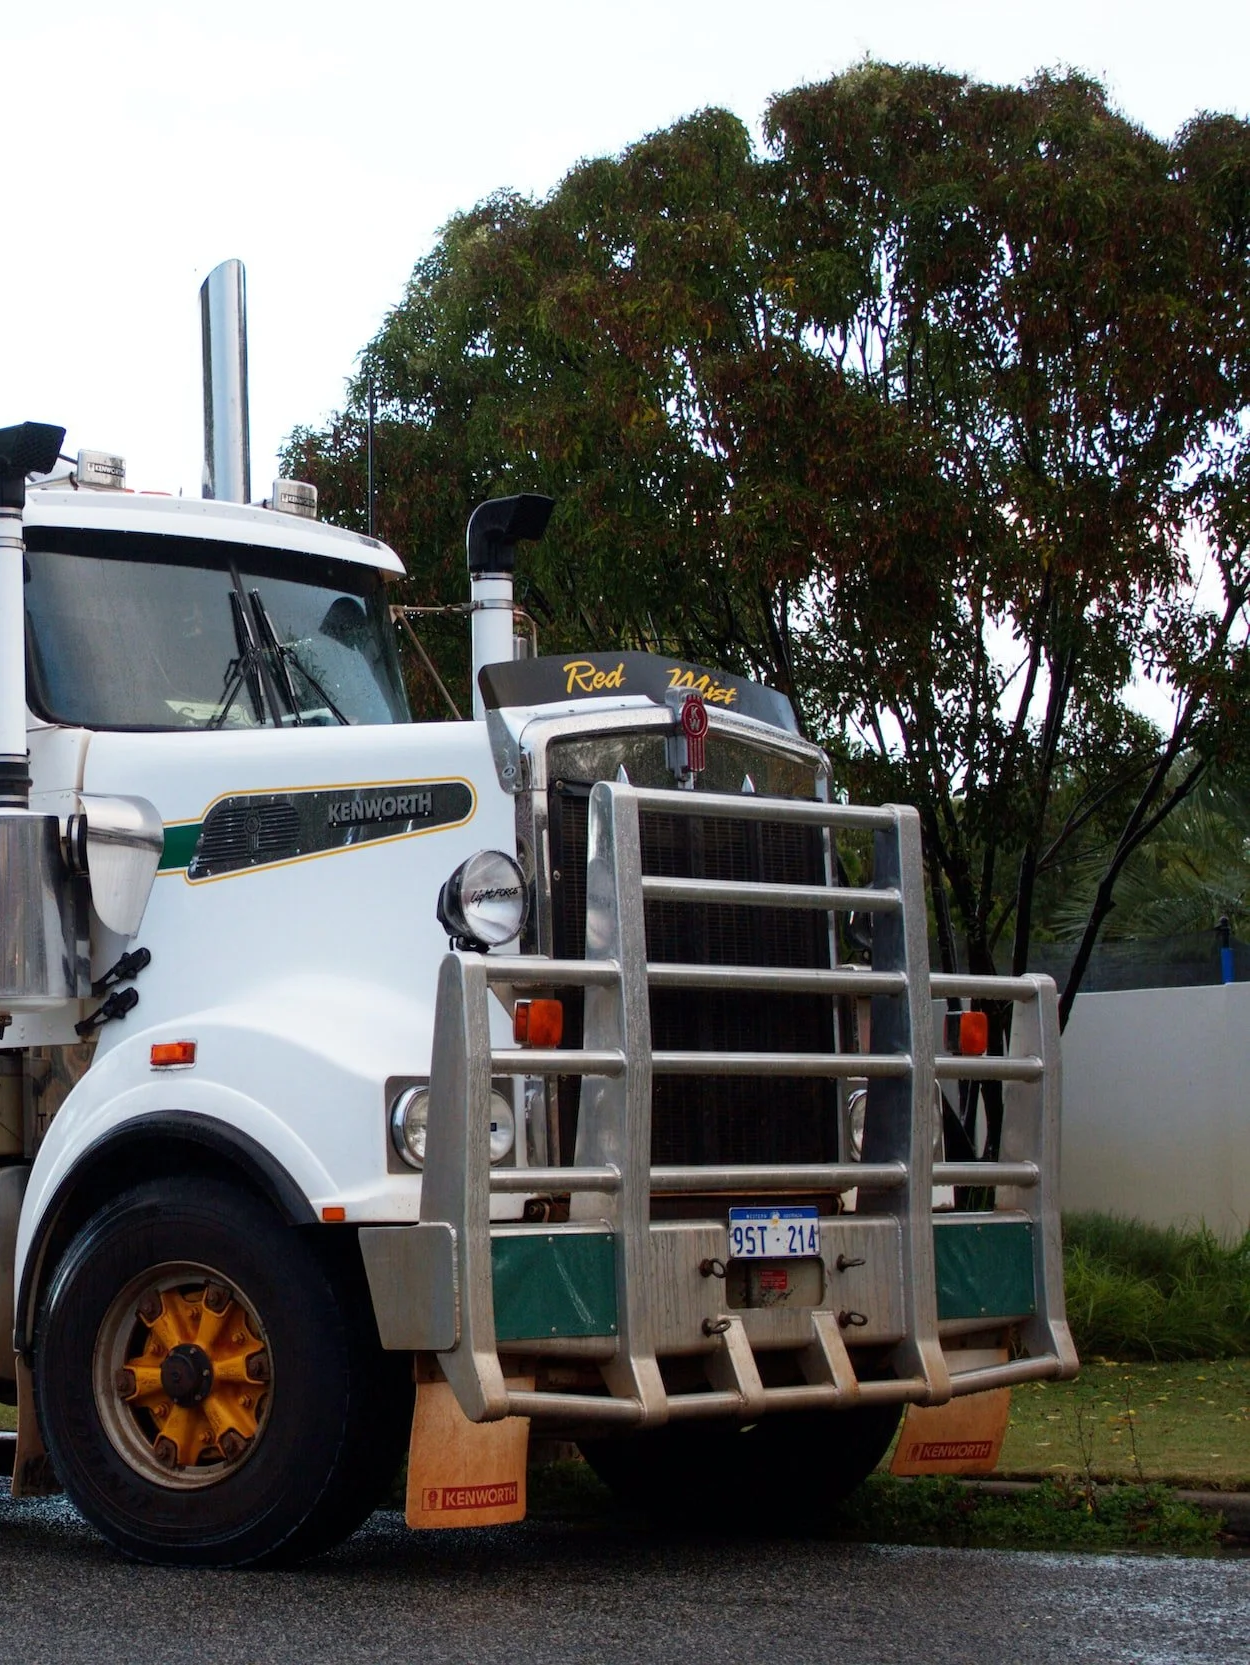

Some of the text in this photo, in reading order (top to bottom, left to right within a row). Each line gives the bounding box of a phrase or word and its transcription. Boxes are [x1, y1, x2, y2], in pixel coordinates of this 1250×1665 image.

[563, 661, 737, 704] Red Mist
[327, 792, 432, 822] KENWORTH
[734, 1224, 816, 1255] 9ST 214
[923, 1444, 989, 1457] KENWORTH
[445, 1487, 516, 1506] KENWORTH
